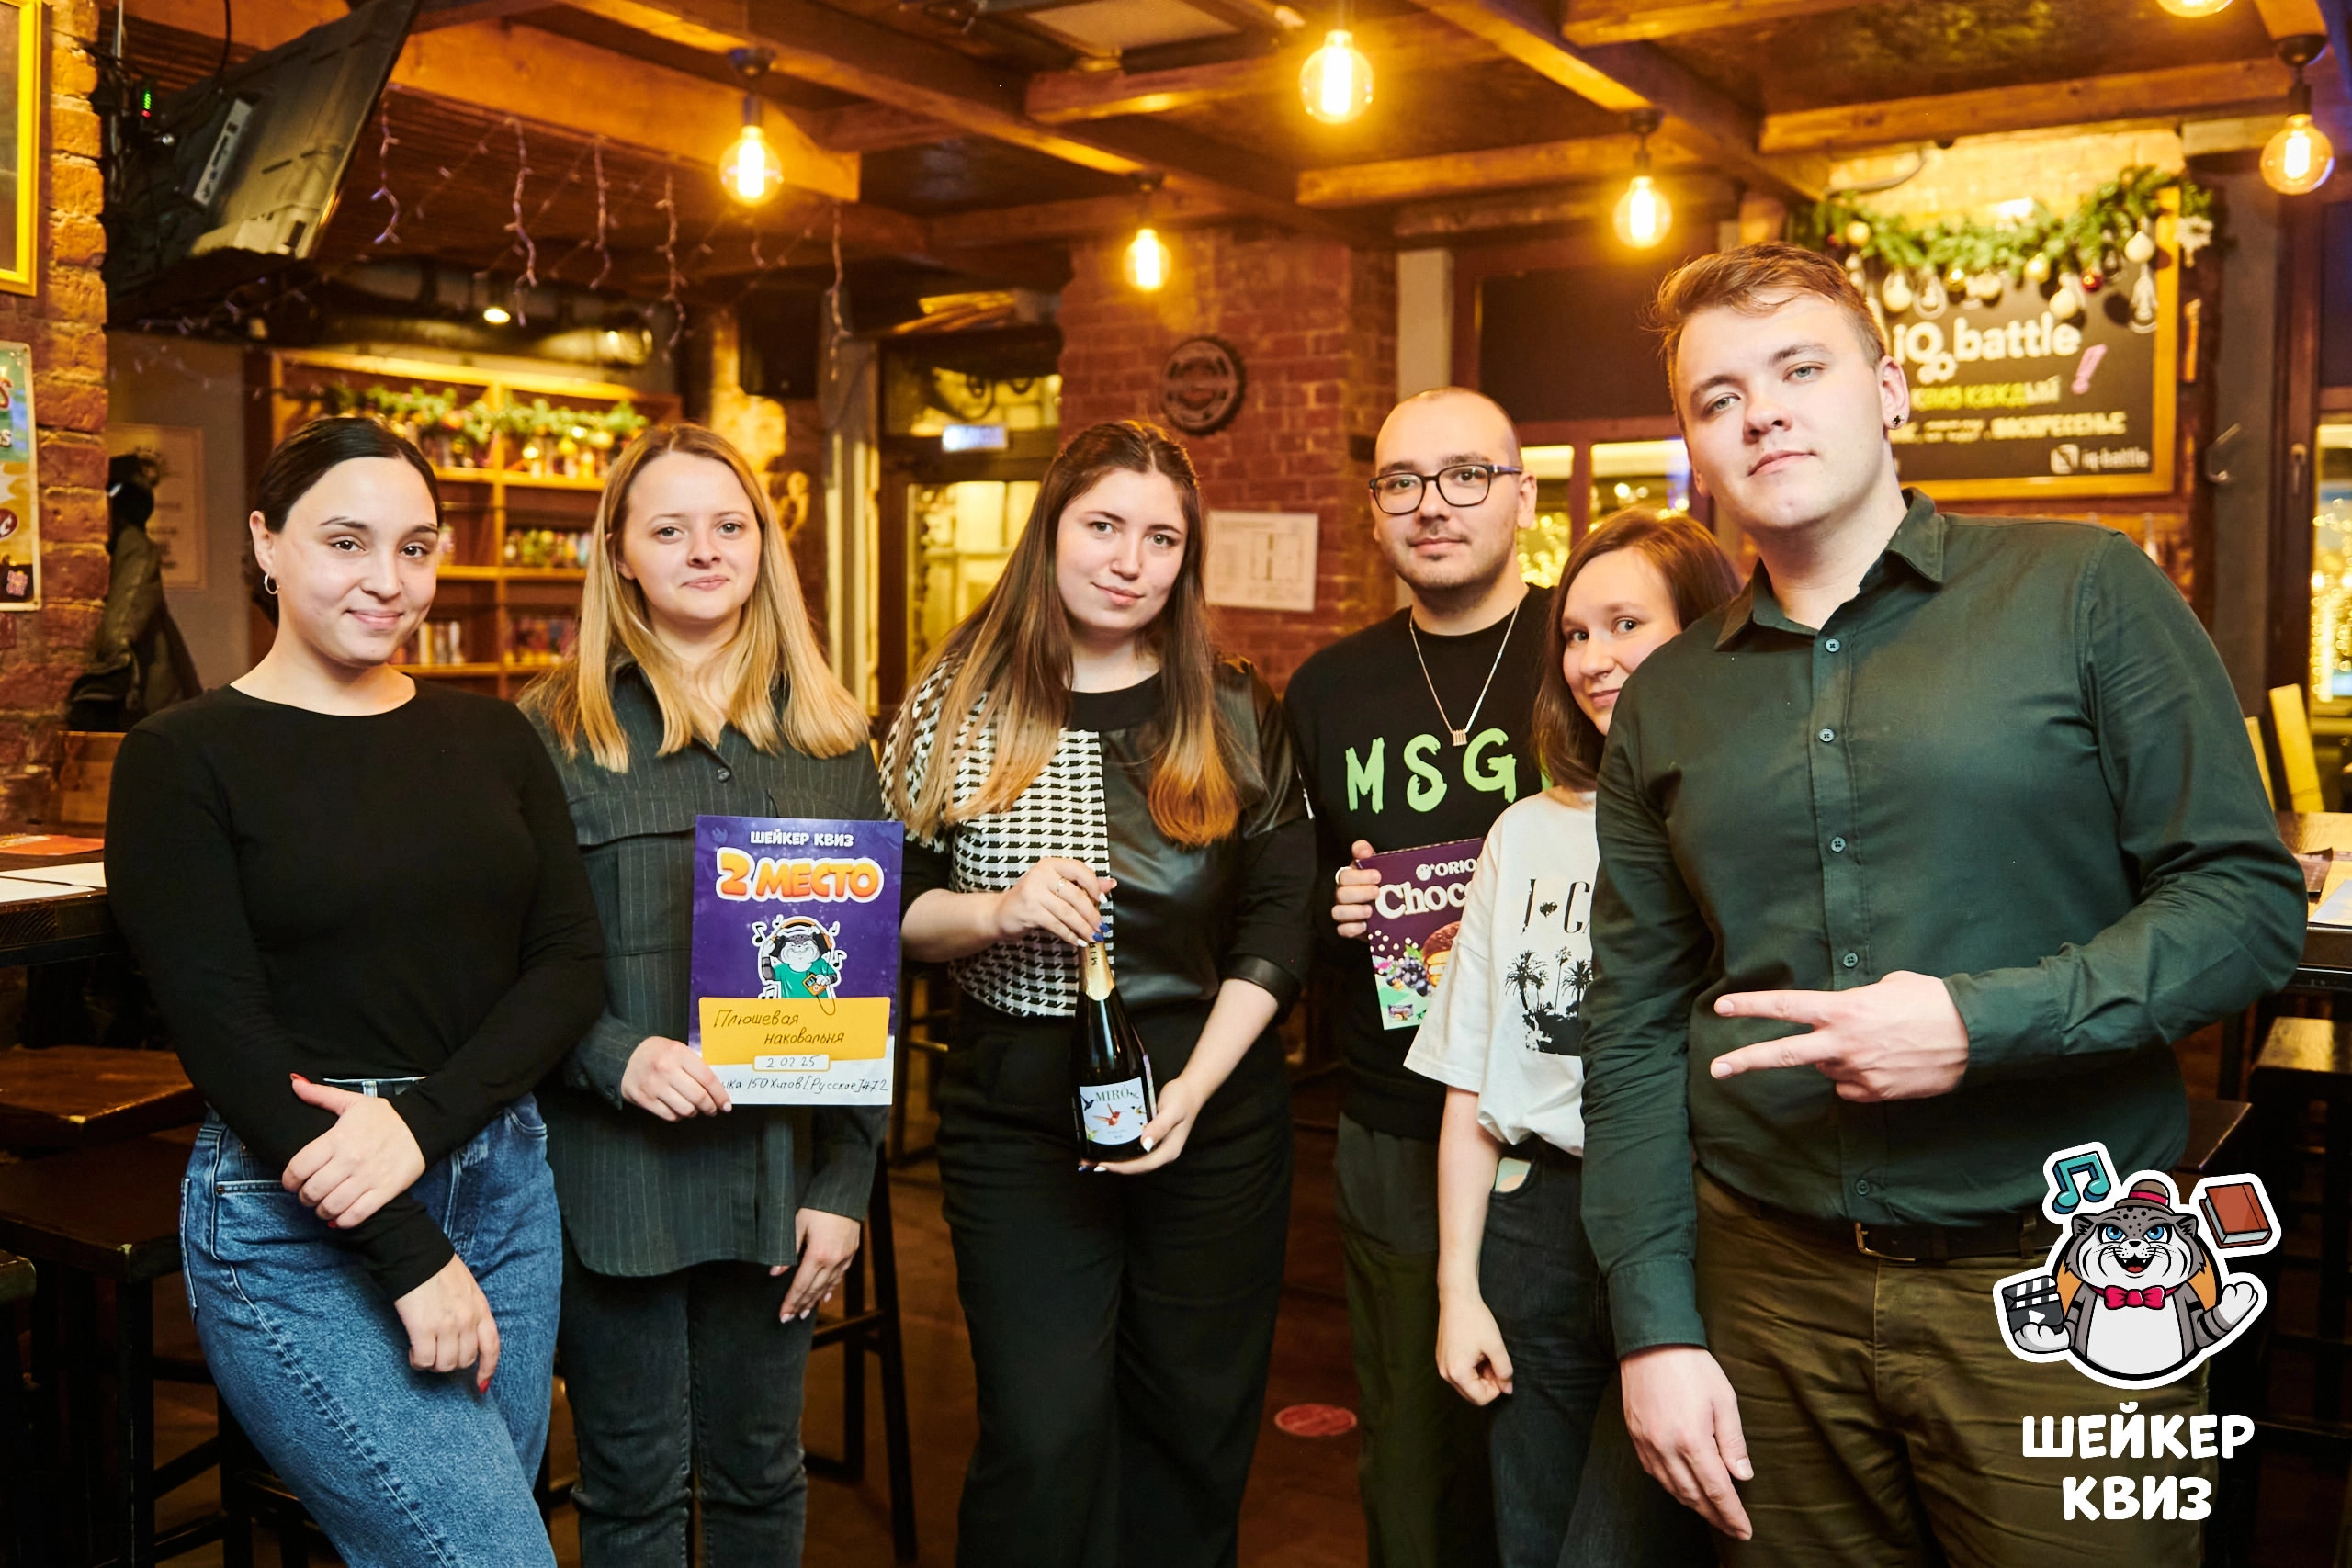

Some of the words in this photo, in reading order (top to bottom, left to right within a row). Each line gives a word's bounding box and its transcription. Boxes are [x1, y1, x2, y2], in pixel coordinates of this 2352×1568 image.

[1953, 310, 2082, 362] battle
[1345, 728, 1553, 814] MSG
[750, 830, 809, 846] ШЕЙКЕР
[813, 833, 854, 847] КВИЗ
[718, 850, 752, 898] 2
[755, 860, 881, 899] МЕСТО
[1434, 858, 1477, 875] ORIO
[1375, 880, 1472, 919] Choc
[1564, 880, 1590, 934] C
[713, 1010, 799, 1028] Плюшевая
[764, 1026, 845, 1044] наковальня
[721, 1078, 741, 1089] ыка
